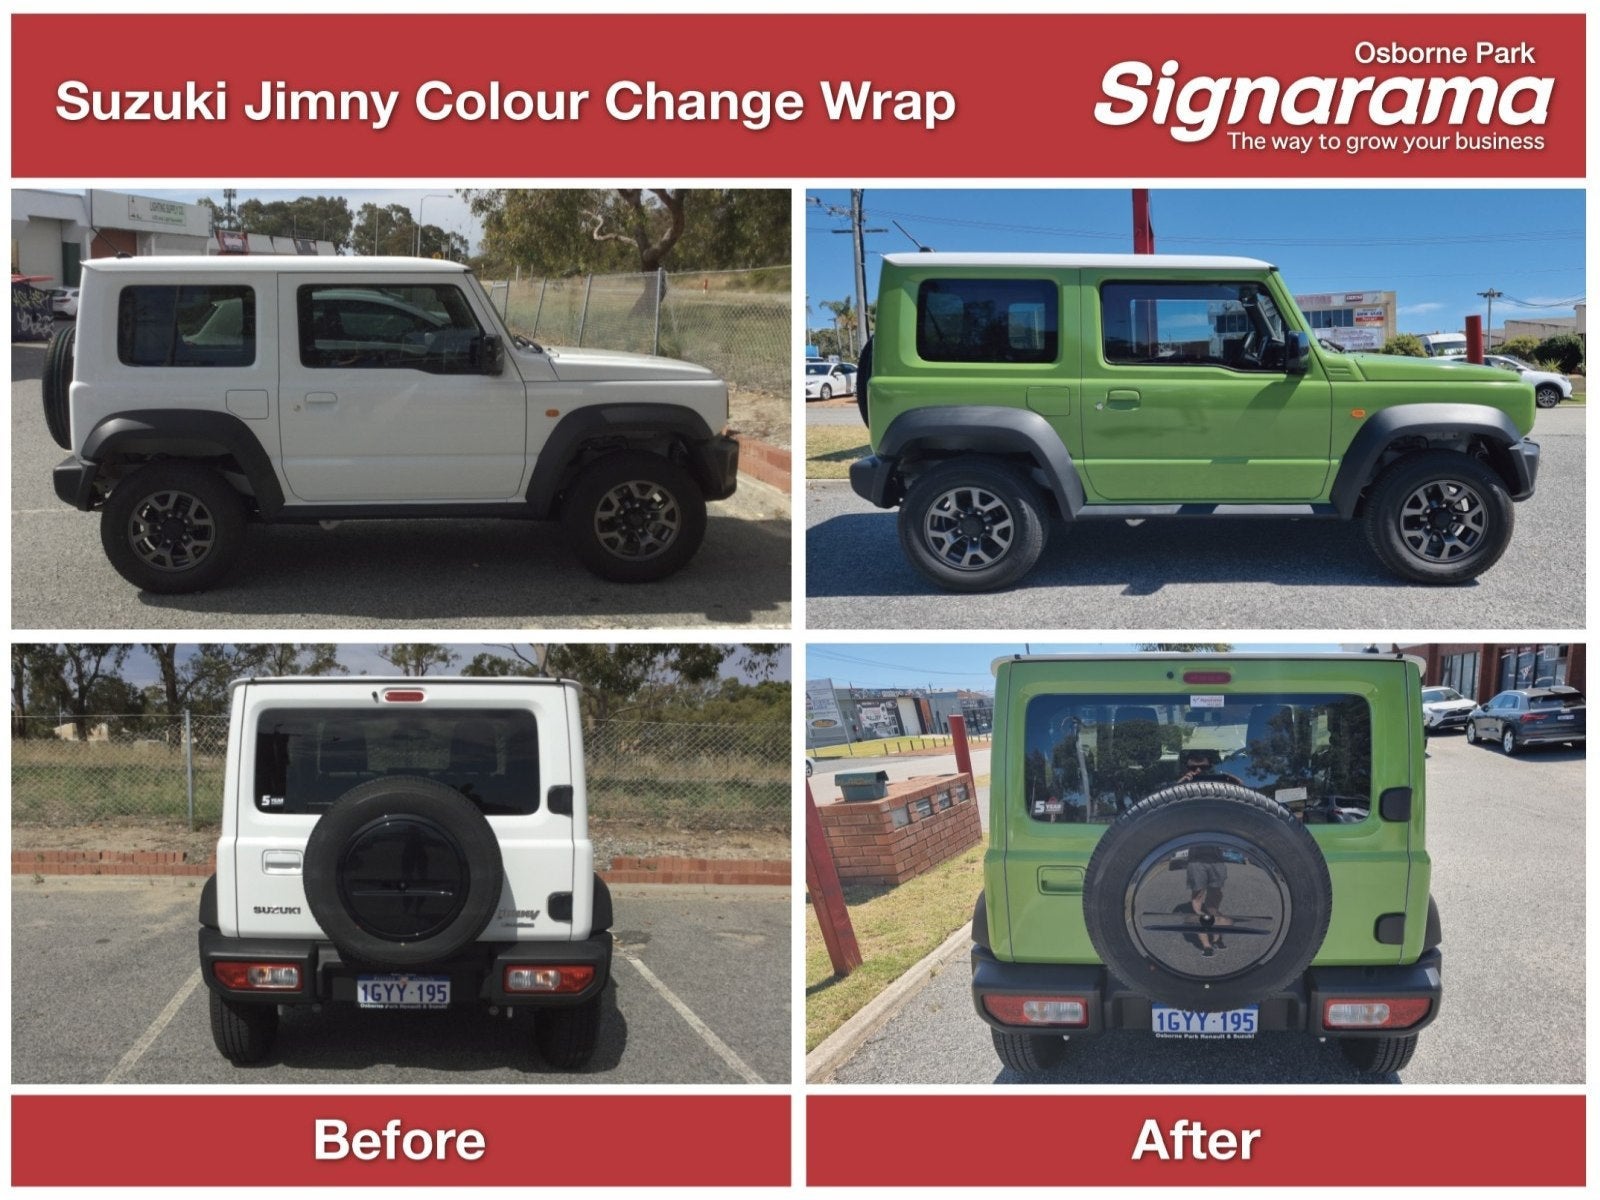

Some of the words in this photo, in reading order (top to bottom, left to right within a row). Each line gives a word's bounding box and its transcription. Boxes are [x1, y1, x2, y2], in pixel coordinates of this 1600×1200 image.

[261, 795, 271, 806] 5
[1034, 800, 1046, 813] 5
[253, 905, 302, 915] SUZUKI
[1183, 1032, 1199, 1040] Park
[1200, 1032, 1225, 1040] Renault
[1233, 1032, 1255, 1040] Suzuki
